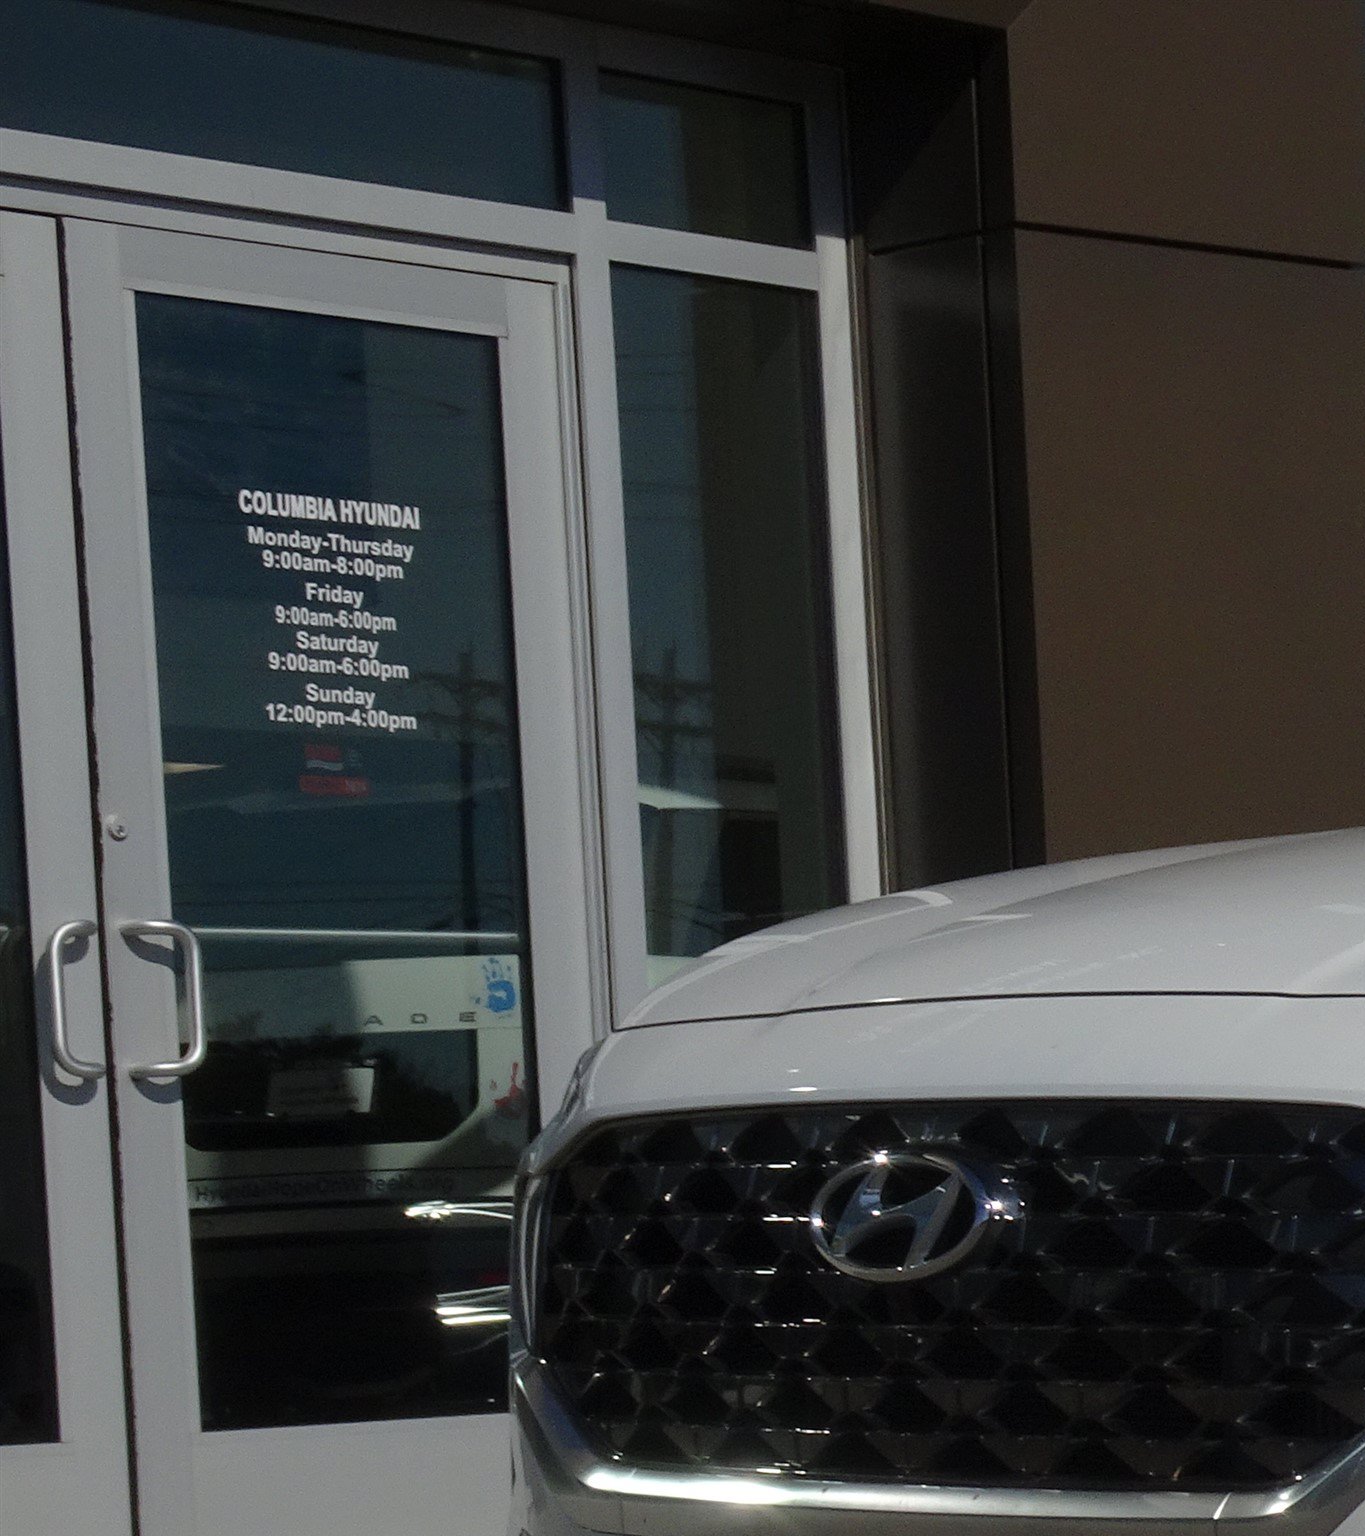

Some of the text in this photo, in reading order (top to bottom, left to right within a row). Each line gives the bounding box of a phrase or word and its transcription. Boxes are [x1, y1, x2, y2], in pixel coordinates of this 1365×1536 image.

[238, 488, 421, 531] COLUMBIA HYUNDAI
[247, 525, 414, 563] Monday-Thursday
[261, 549, 404, 582] 9:00am-8:00pm
[304, 582, 364, 609] Friday
[274, 604, 398, 635] 9:00am-6:00pm
[295, 630, 379, 659] Saturday
[267, 651, 410, 682] 9:00am-6:00pm
[305, 682, 376, 709] Sunday
[265, 702, 418, 733] 12:00pm-4:00pm
